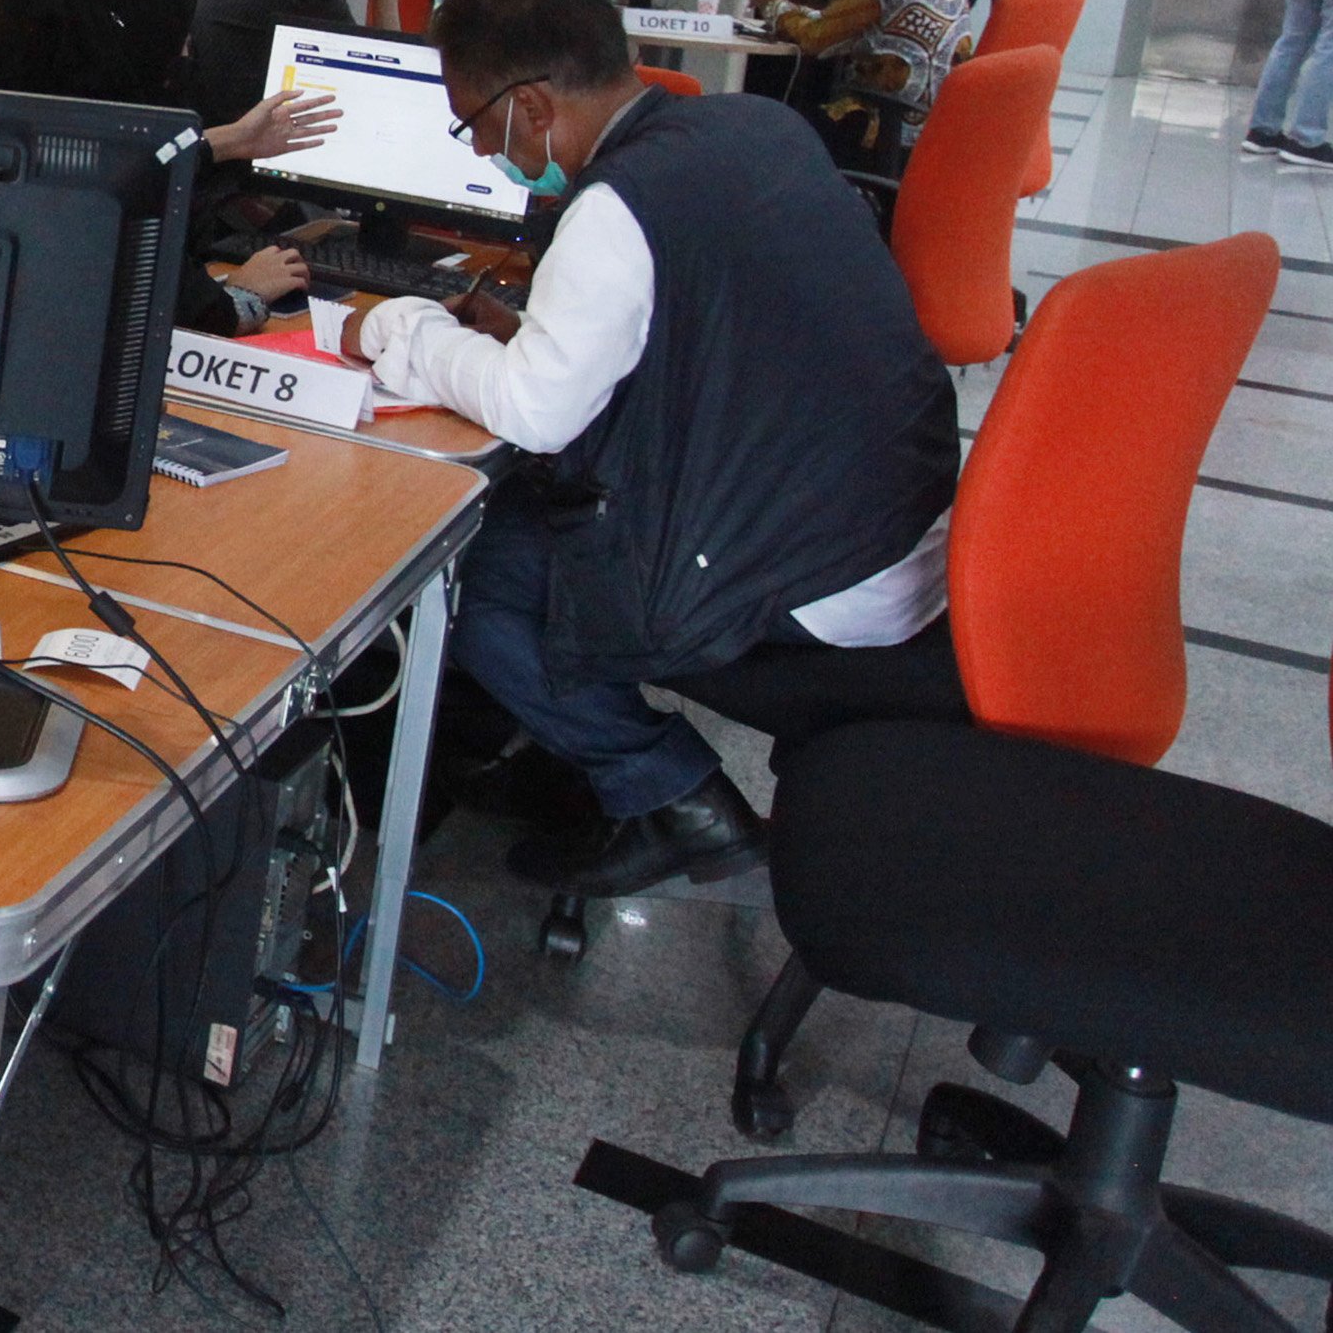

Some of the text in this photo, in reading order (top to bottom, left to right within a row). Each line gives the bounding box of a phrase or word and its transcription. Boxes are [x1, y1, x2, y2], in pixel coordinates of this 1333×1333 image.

[639, 16, 710, 34] LOKET 10
[274, 373, 298, 402] 8
